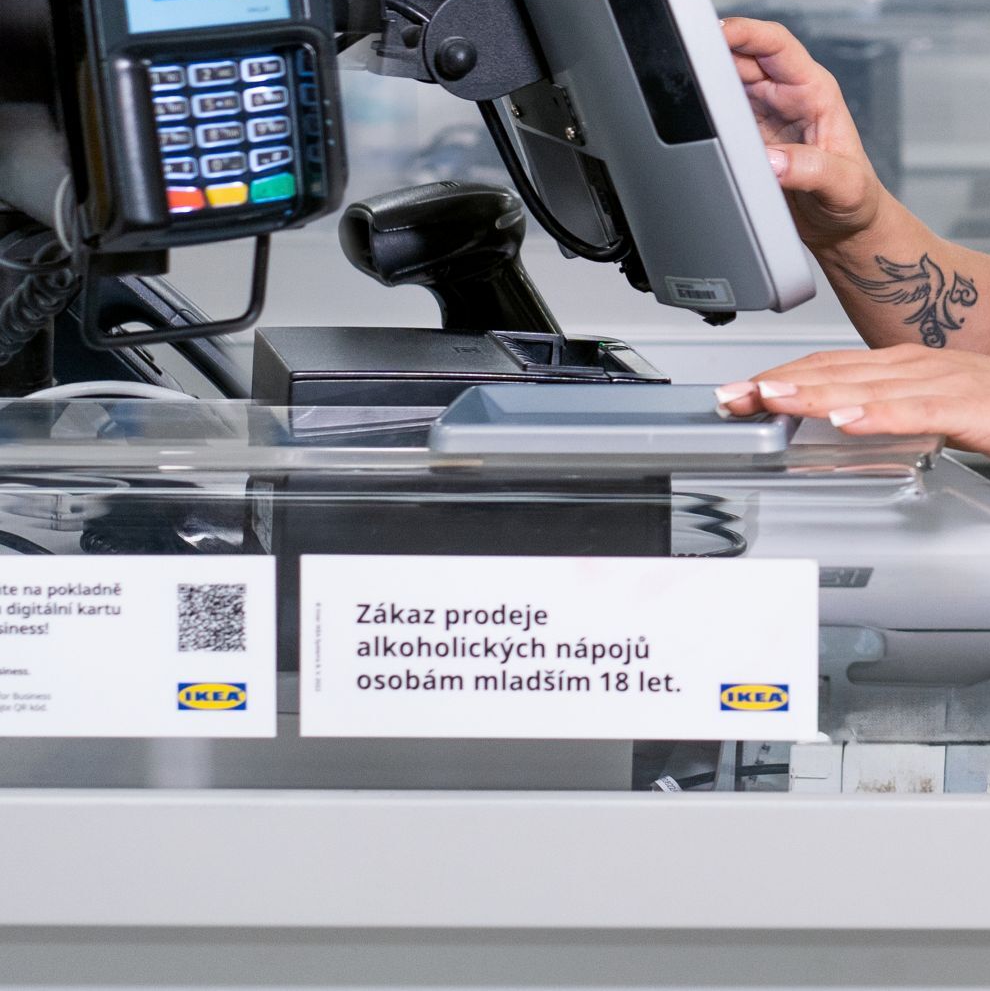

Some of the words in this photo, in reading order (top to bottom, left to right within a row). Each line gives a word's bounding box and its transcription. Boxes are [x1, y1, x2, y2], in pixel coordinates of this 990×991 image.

[23, 585, 42, 596] na
[48, 583, 122, 599] pokladně
[6, 602, 72, 619] digitální
[77, 602, 121, 615] kartu
[356, 602, 435, 625] Zákaz
[445, 603, 548, 632] prodeje
[356, 635, 546, 665] alkoholických
[556, 635, 649, 666] nápojů
[356, 669, 464, 691] osobám
[474, 669, 590, 692] mladším
[601, 671, 629, 691] 18
[640, 670, 681, 692] let.
